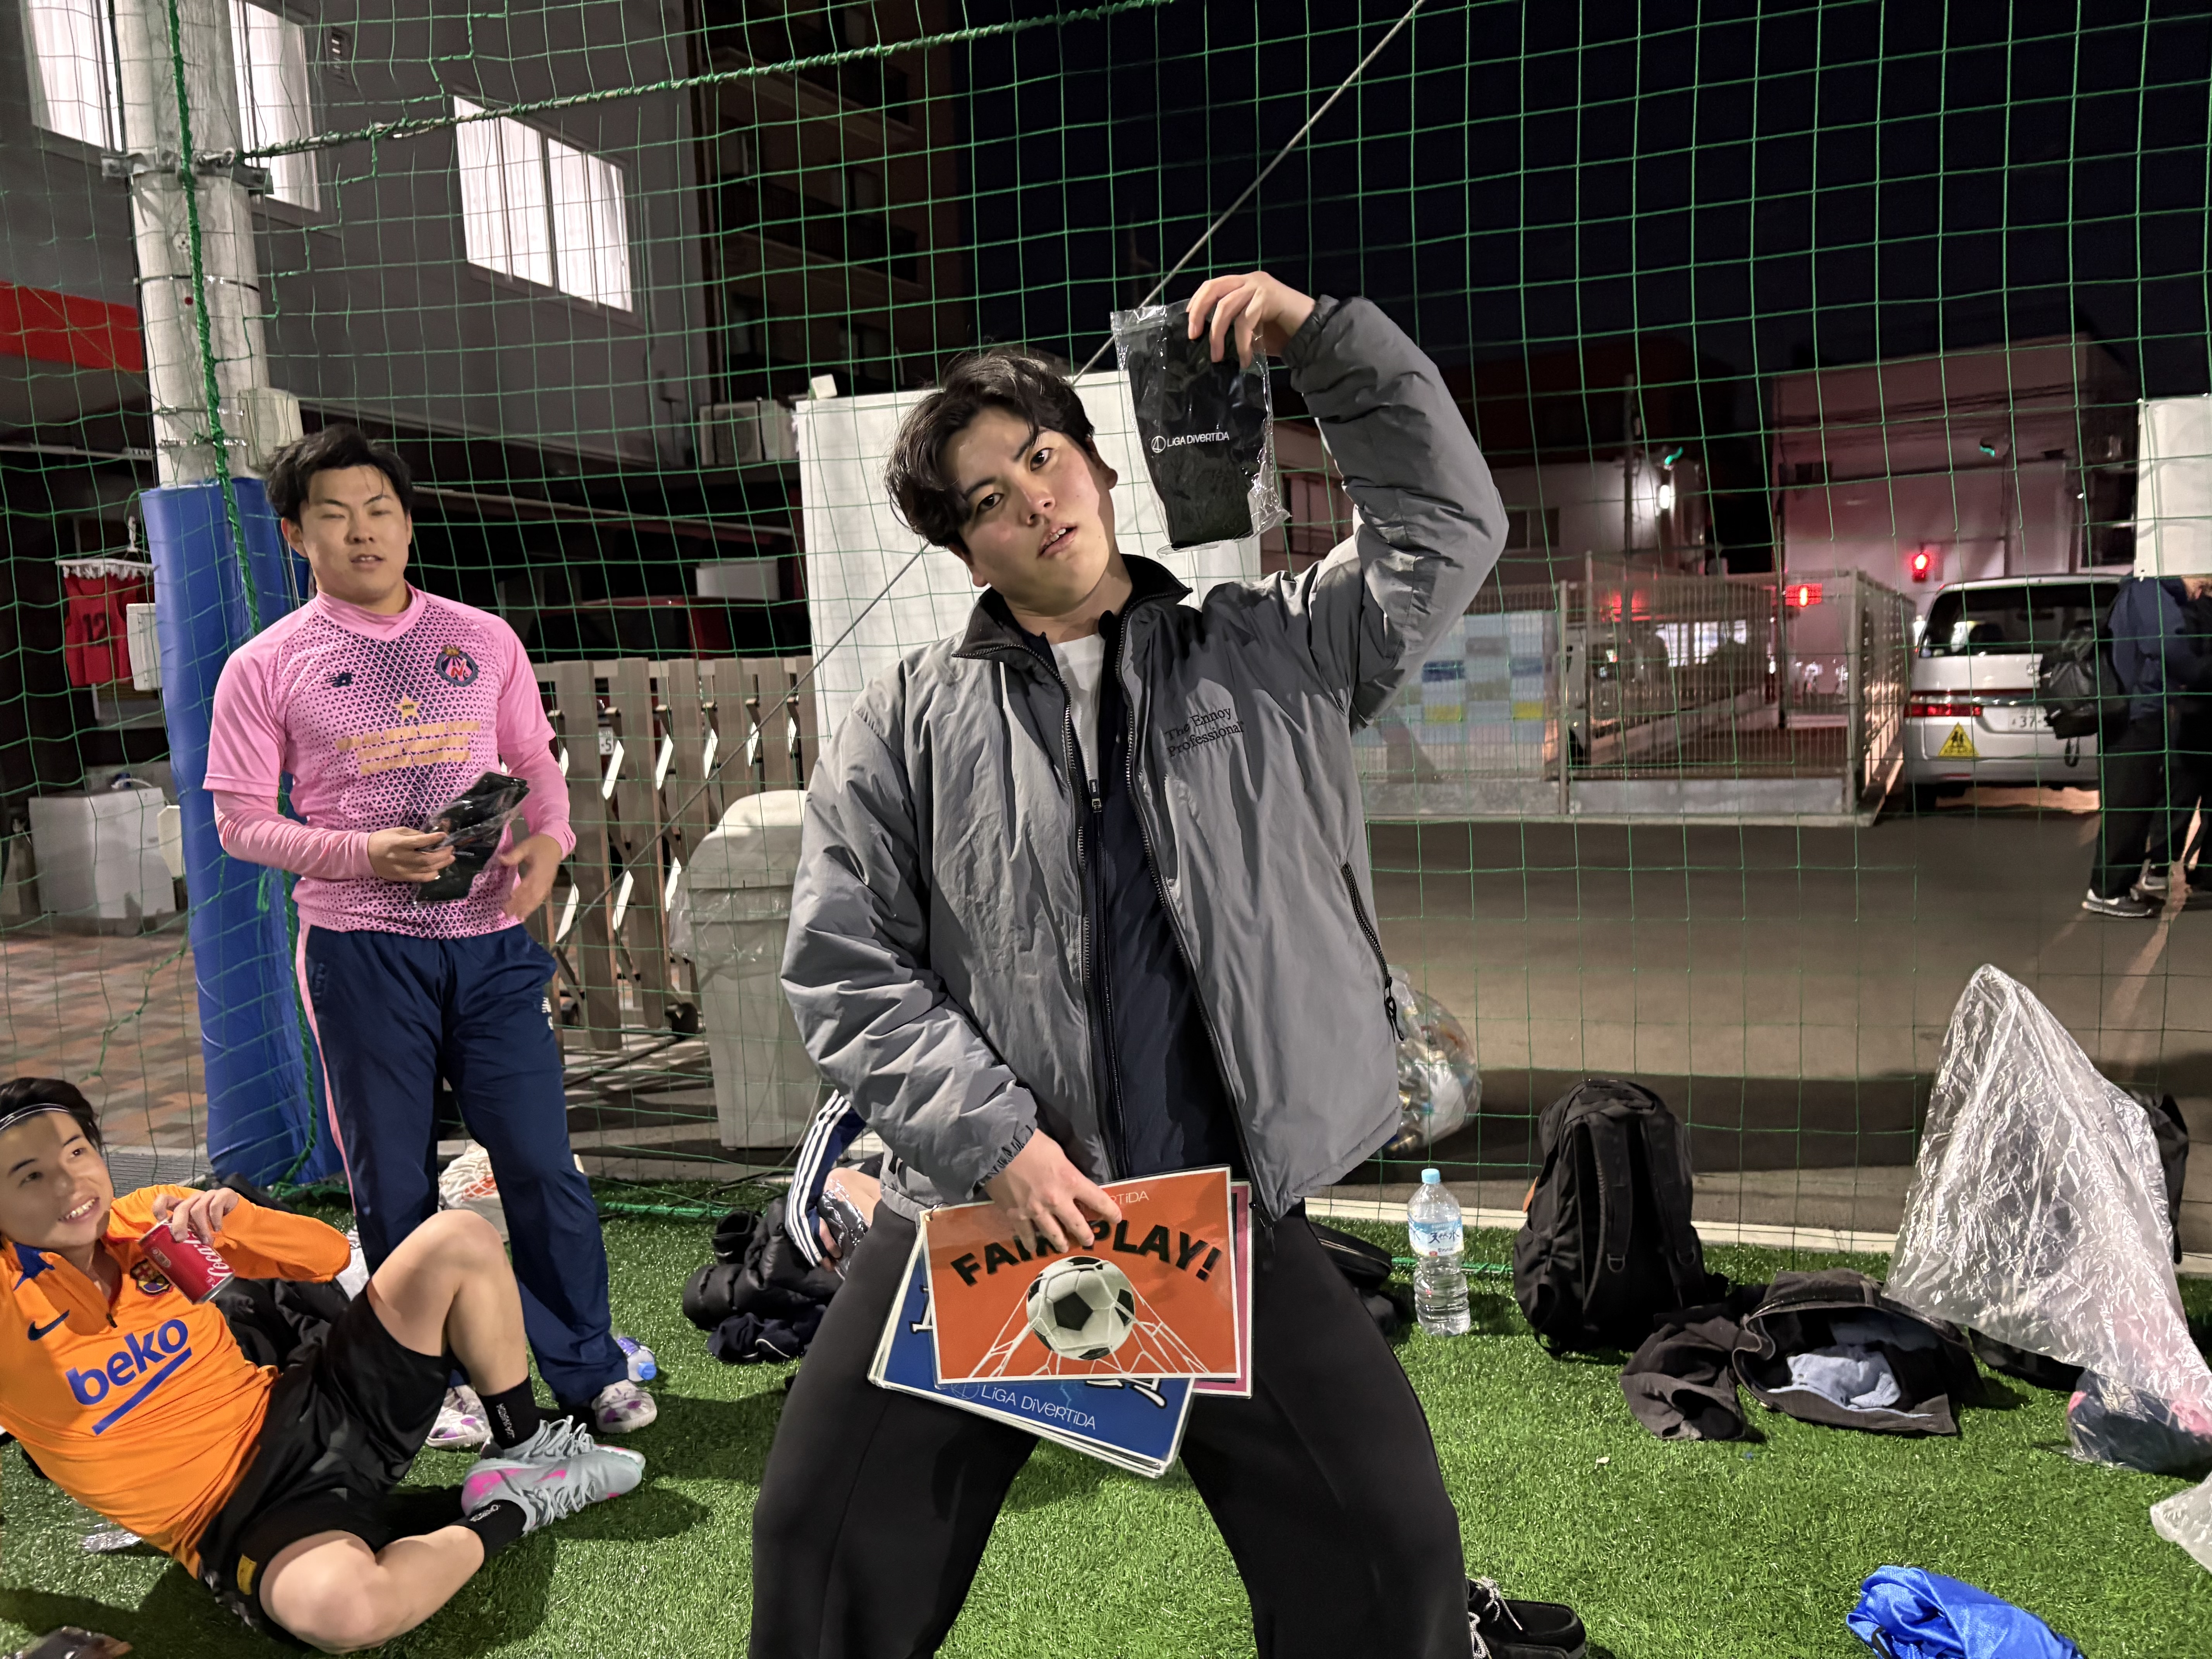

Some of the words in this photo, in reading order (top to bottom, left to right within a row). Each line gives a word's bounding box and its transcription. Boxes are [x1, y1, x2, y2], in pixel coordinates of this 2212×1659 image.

[1165, 723, 1190, 740] The
[1189, 708, 1231, 726] Ennoy
[1167, 721, 1244, 757] Professional
[1082, 1219, 1223, 1282] PLAY!
[66, 1319, 189, 1405] beko
